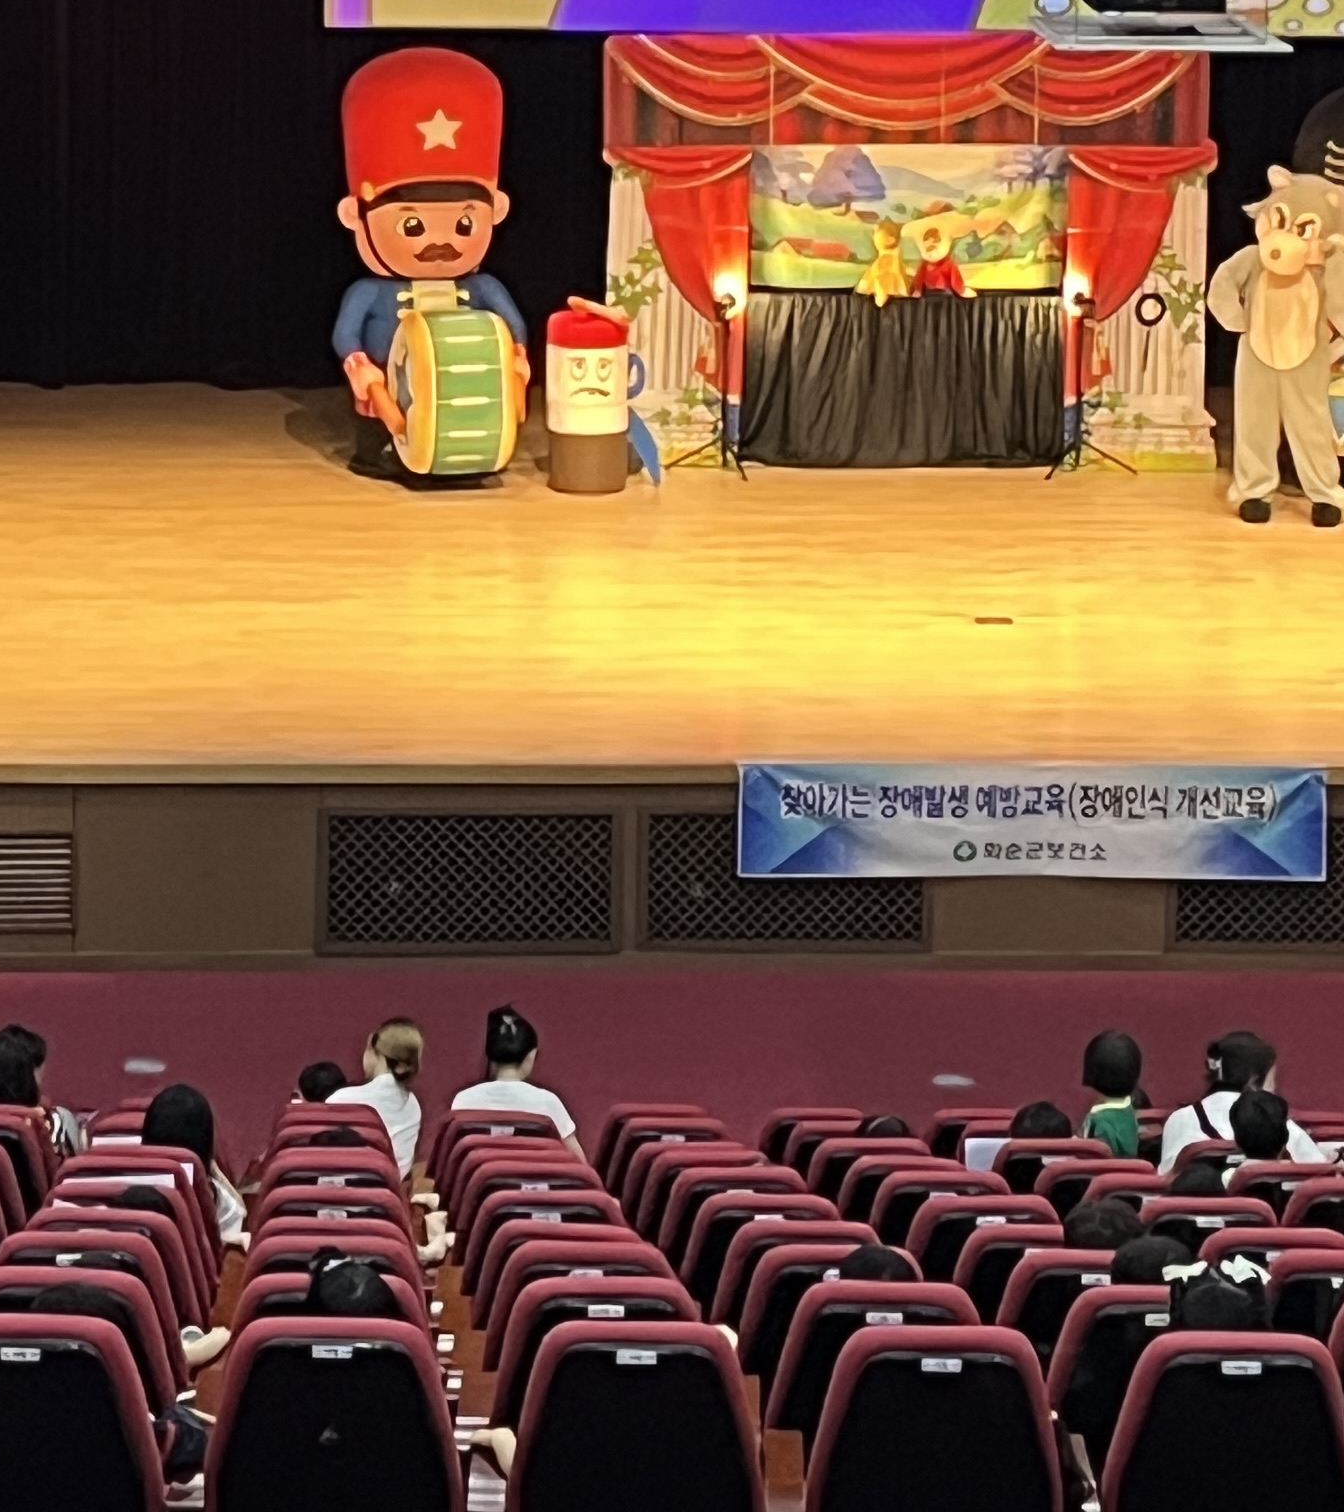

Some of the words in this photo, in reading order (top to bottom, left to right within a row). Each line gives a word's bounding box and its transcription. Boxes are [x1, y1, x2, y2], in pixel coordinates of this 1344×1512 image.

[780, 782, 872, 819] 찾아가는
[878, 783, 970, 819] 장애발생
[1175, 783, 1278, 822] 개선교육)
